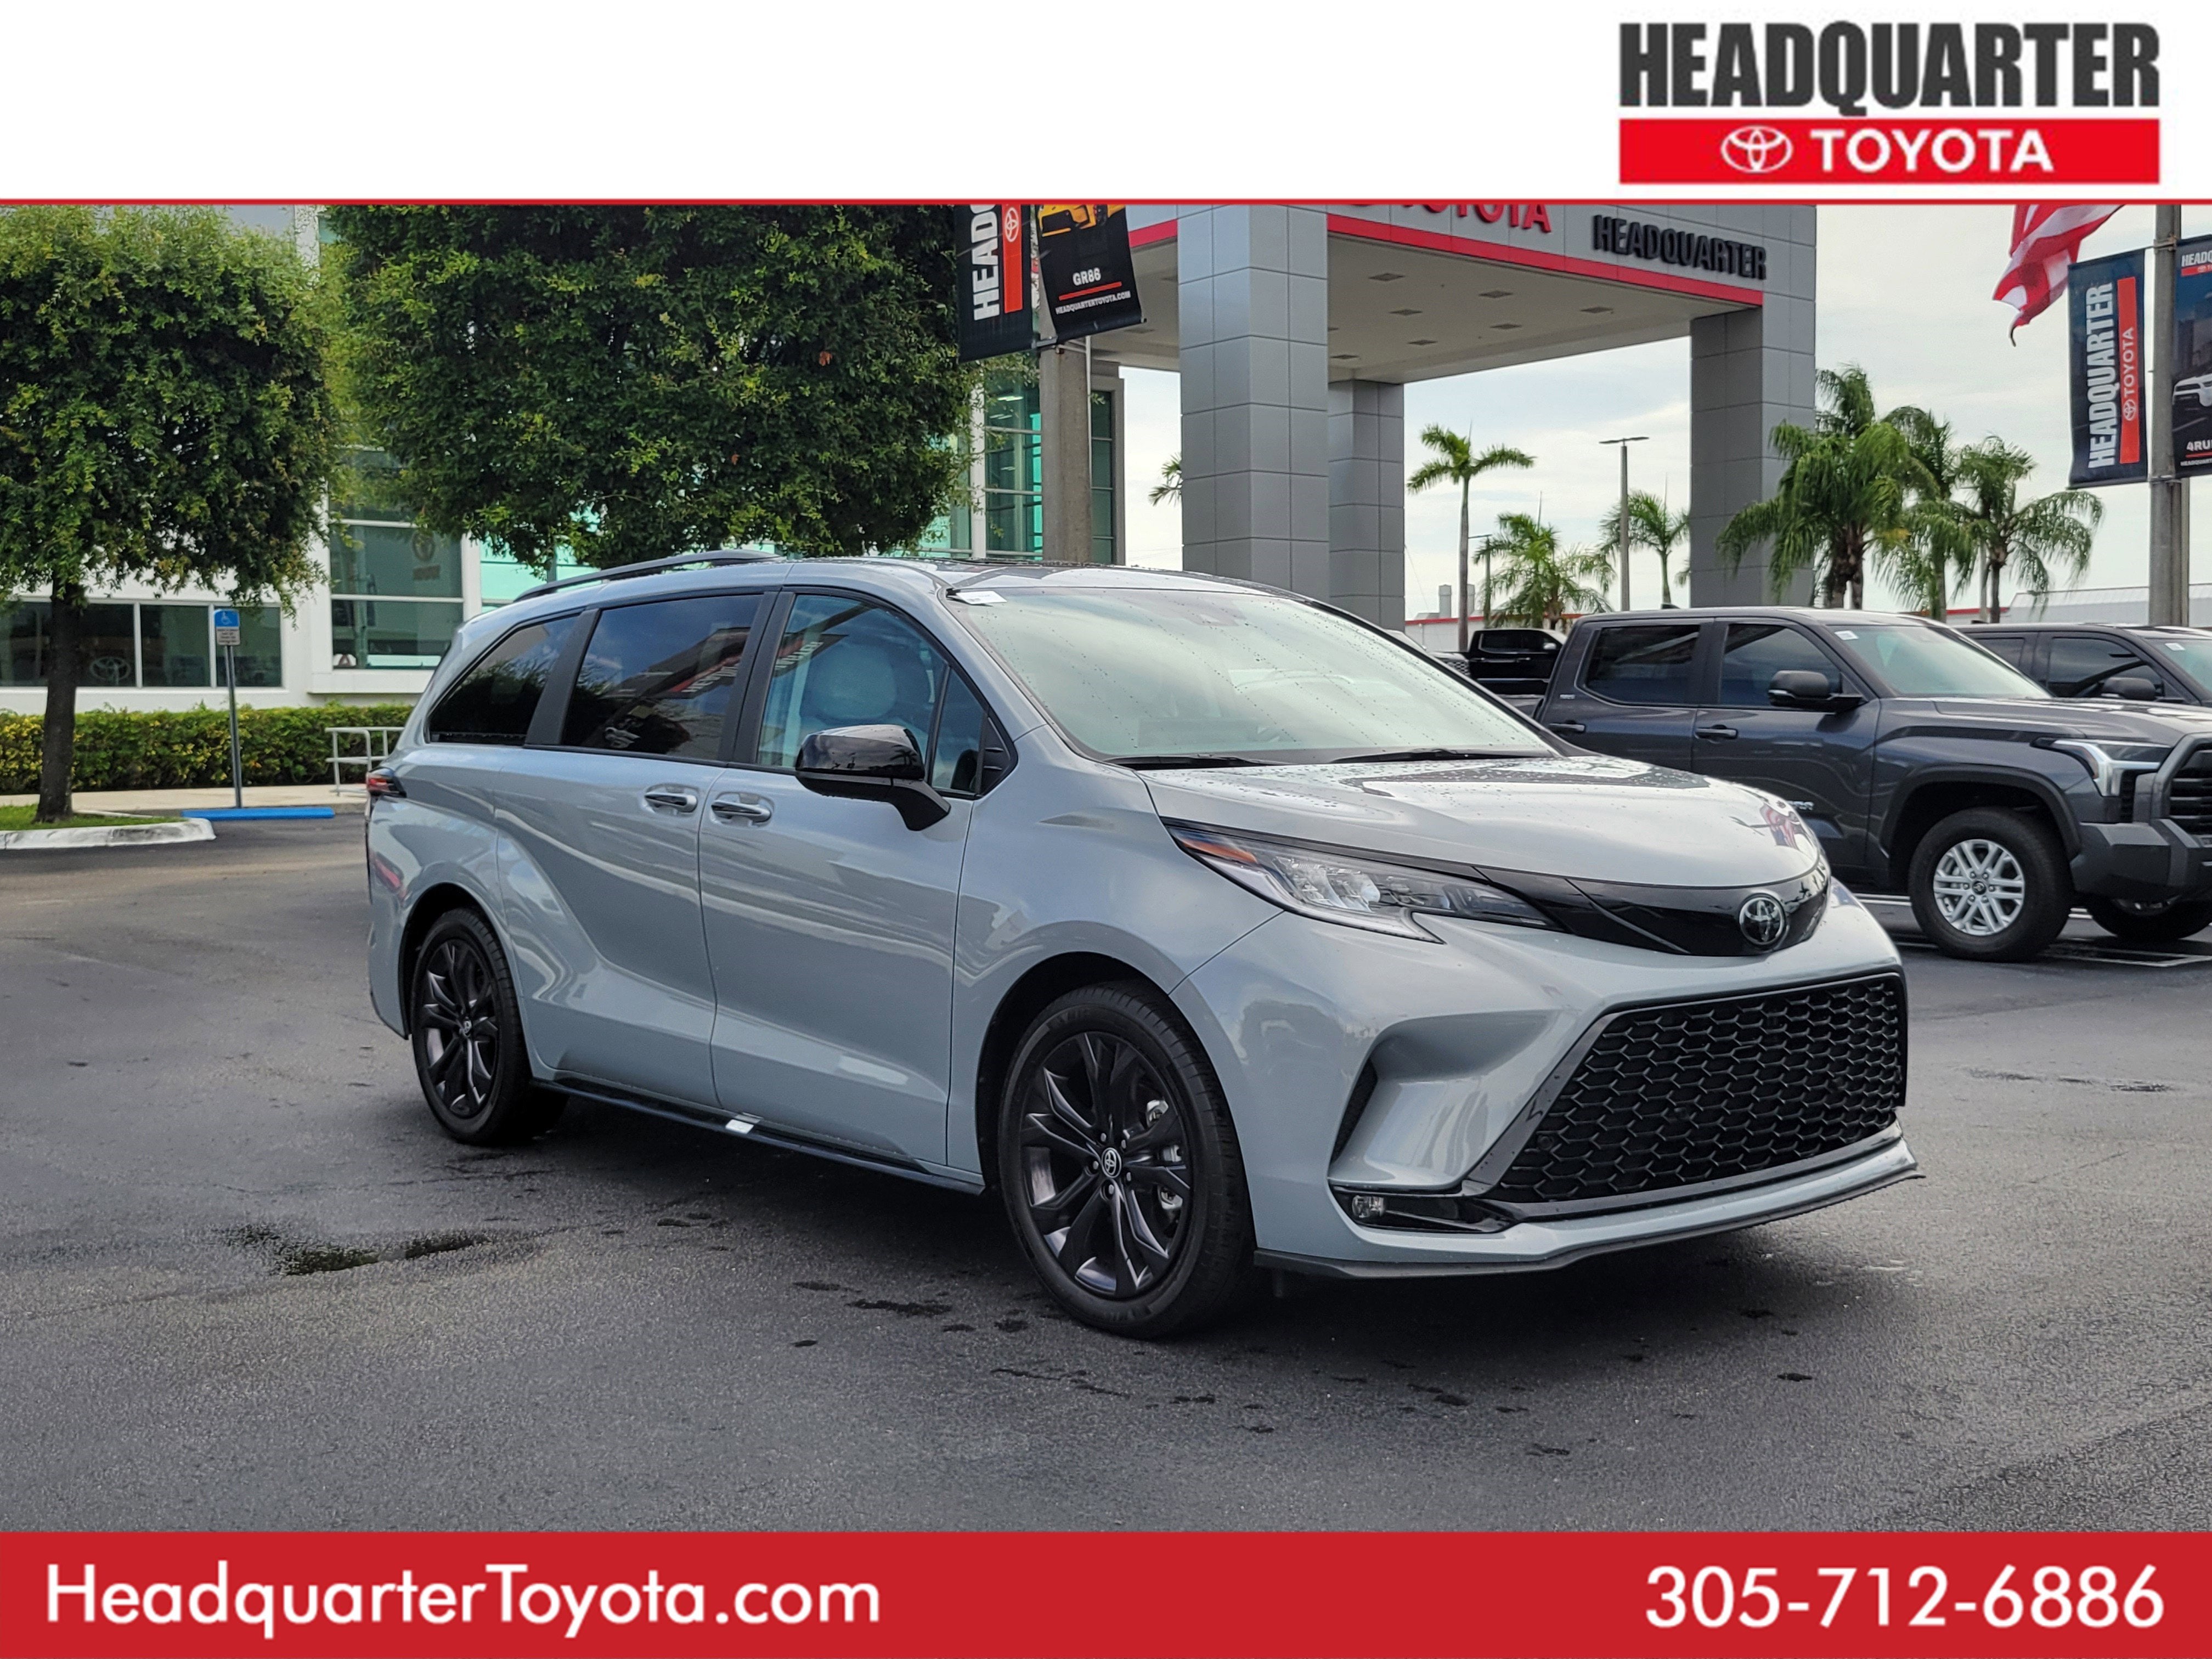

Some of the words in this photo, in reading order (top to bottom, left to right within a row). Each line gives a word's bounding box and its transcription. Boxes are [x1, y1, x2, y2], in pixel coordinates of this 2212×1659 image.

[1073, 267, 1102, 286] GR86
[1593, 215, 1766, 280] HEADQUARTER
[2086, 282, 2120, 469] HEADQUARTER
[2123, 328, 2135, 398] TOYOTA
